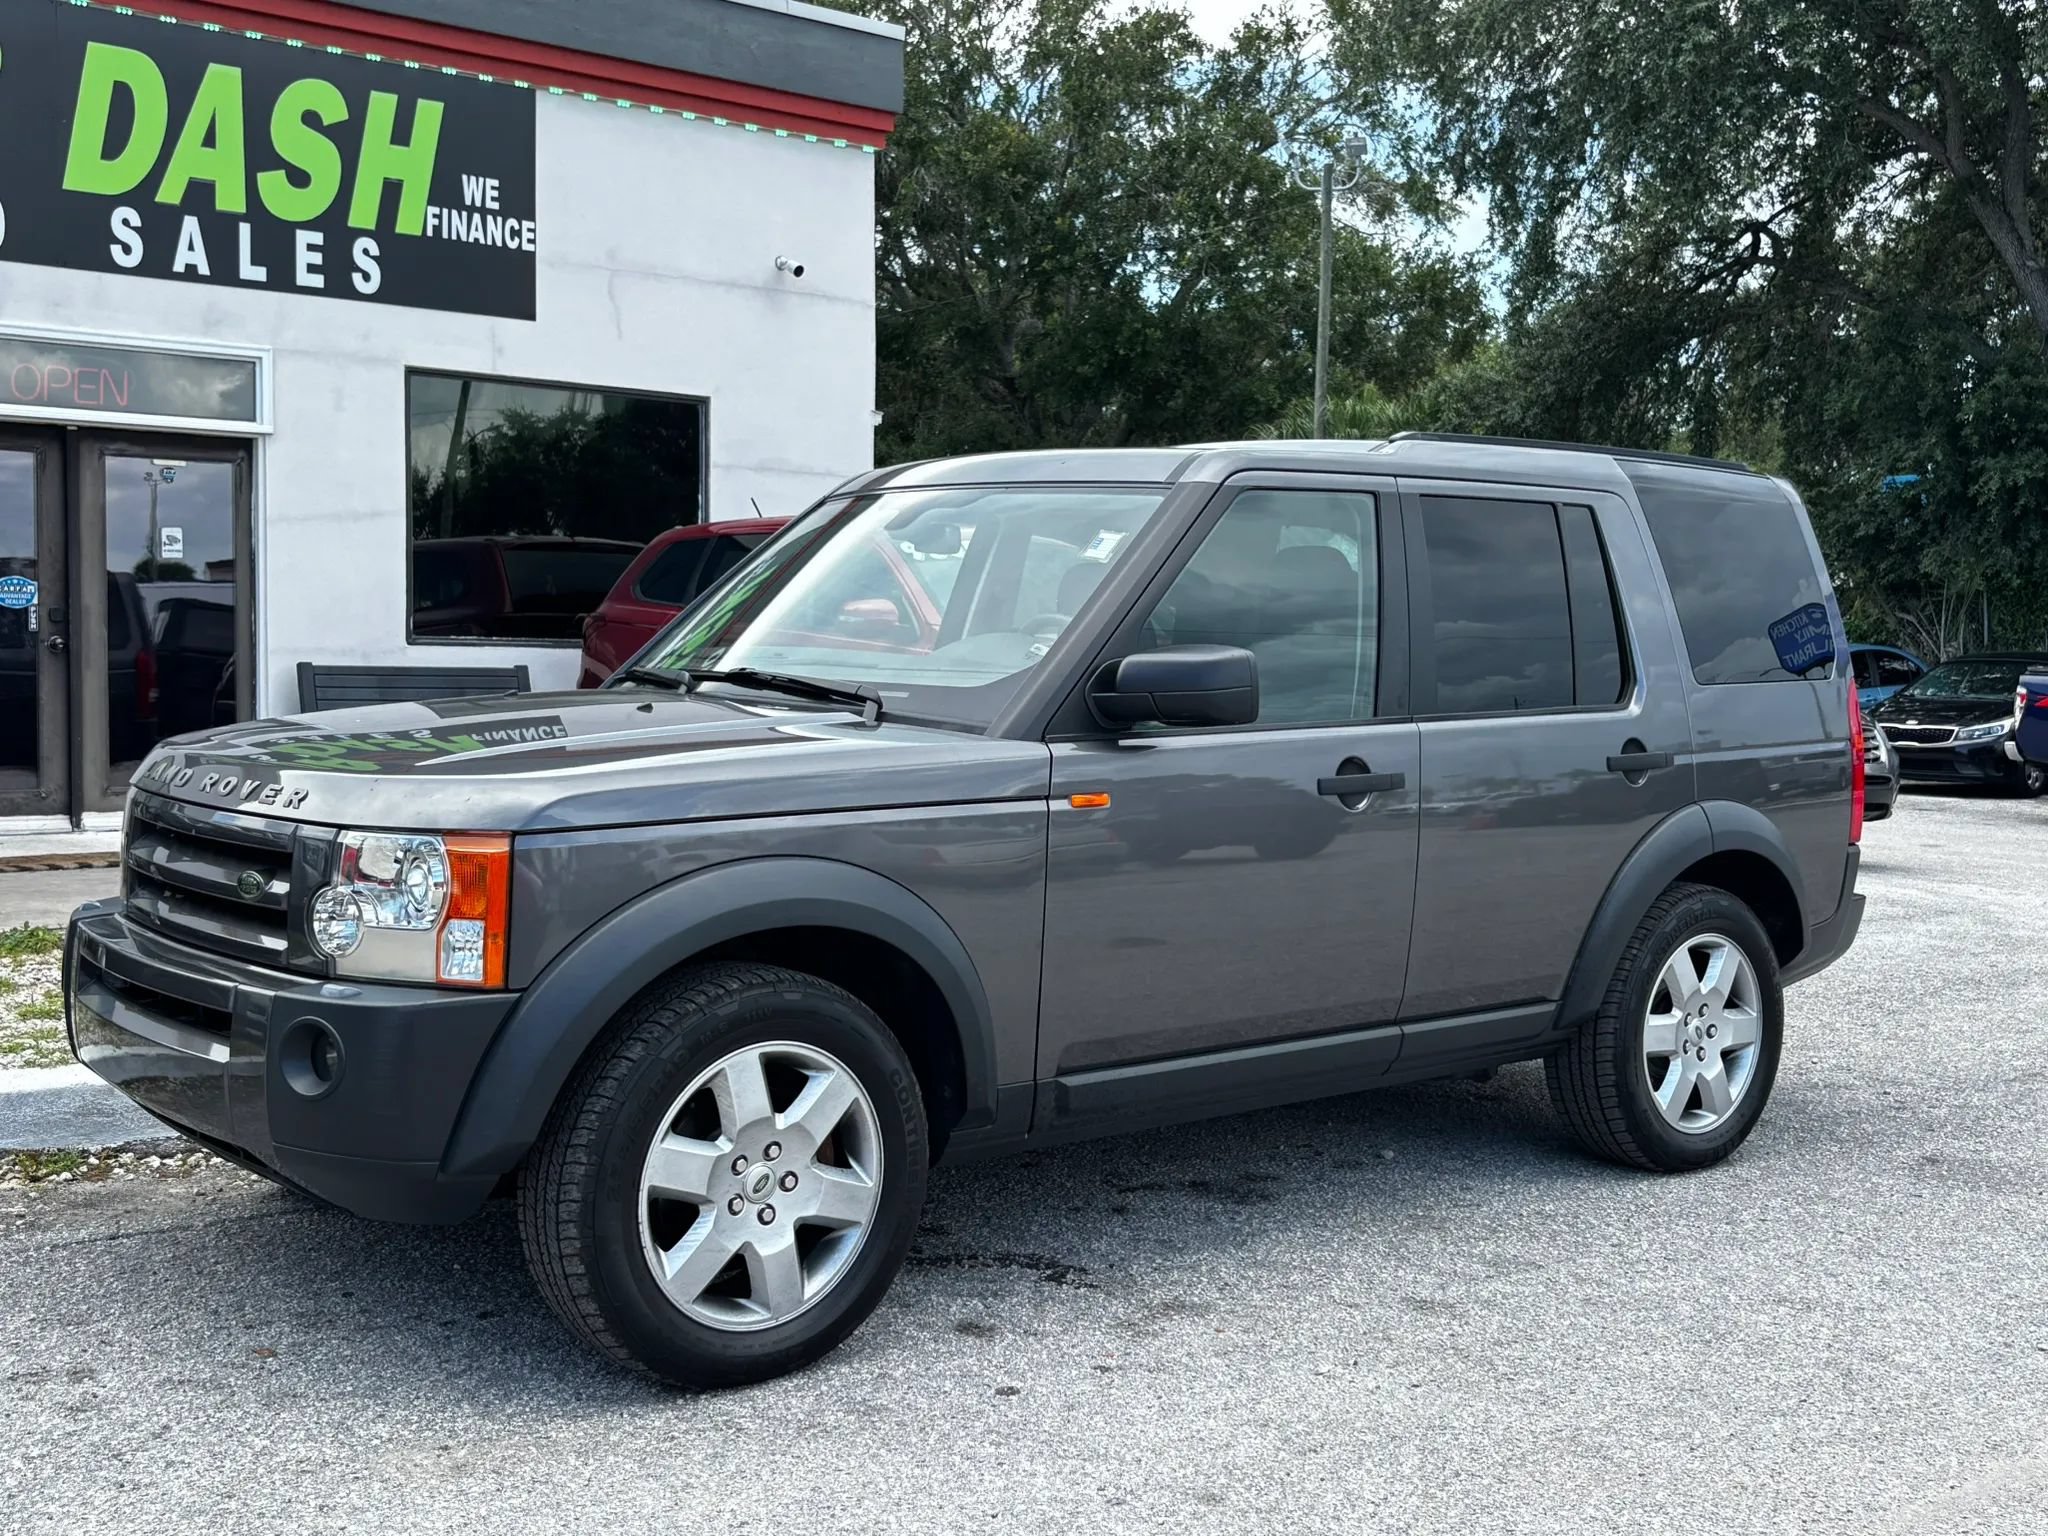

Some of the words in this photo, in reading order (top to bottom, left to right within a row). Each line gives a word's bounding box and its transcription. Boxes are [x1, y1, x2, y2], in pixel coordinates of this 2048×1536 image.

[62, 41, 444, 236] DASH
[462, 174, 500, 209] WE
[110, 206, 381, 295] SALES
[426, 206, 536, 252] FINANCE
[11, 364, 129, 406] OPEN
[143, 760, 195, 788] LAND
[199, 772, 309, 809] ROVER
